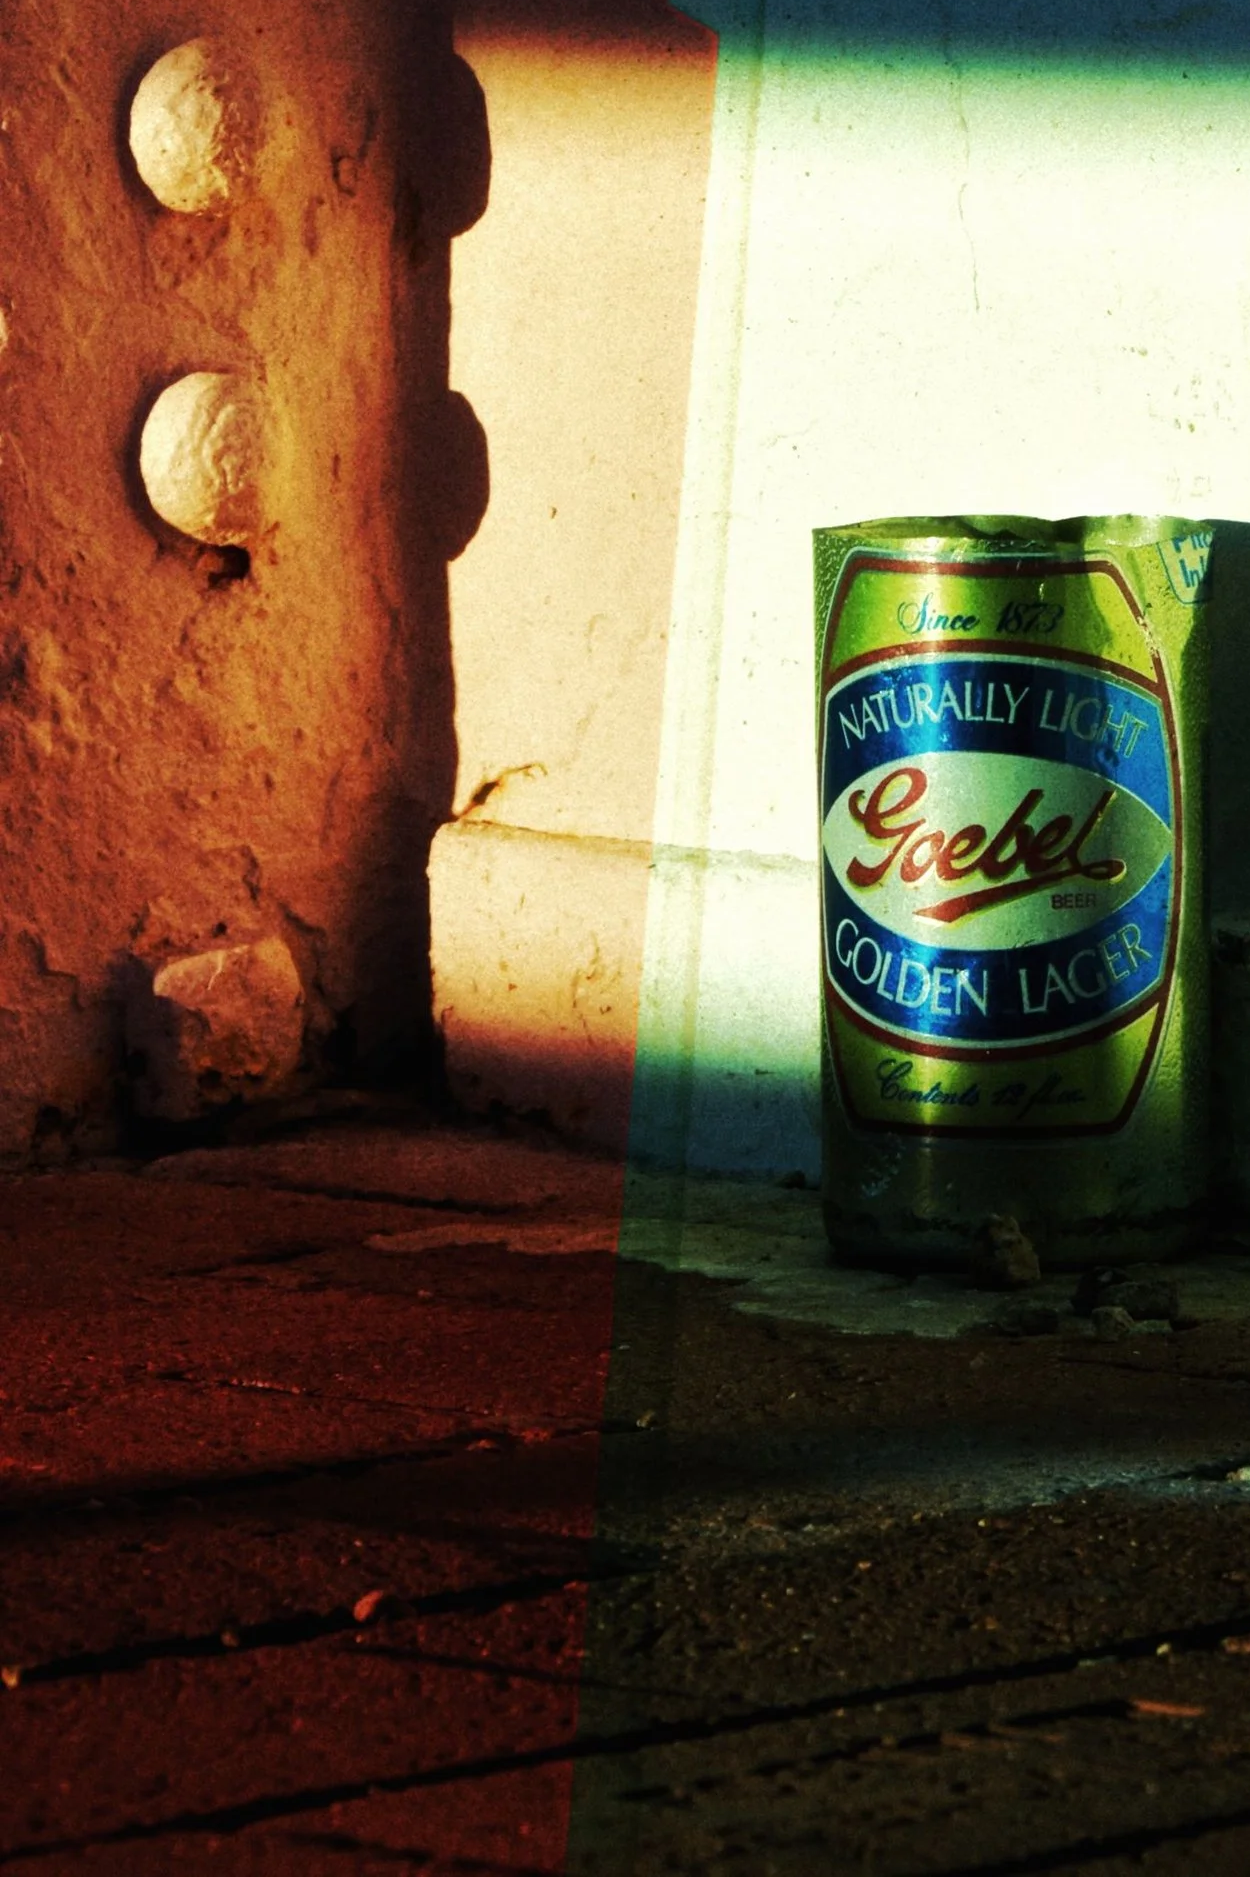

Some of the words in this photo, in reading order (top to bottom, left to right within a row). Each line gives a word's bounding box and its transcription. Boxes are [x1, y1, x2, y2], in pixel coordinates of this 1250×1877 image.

[897, 592, 980, 634] Since
[996, 600, 1064, 634] 1873
[838, 681, 1030, 748] NATURALLY
[1040, 691, 1149, 759] LIGHT
[845, 767, 1127, 921] Goebel
[1051, 893, 1097, 910] BEER
[835, 918, 990, 1015] GOLDEN
[1019, 922, 1153, 1014] LAGER
[876, 1059, 980, 1106] Contents
